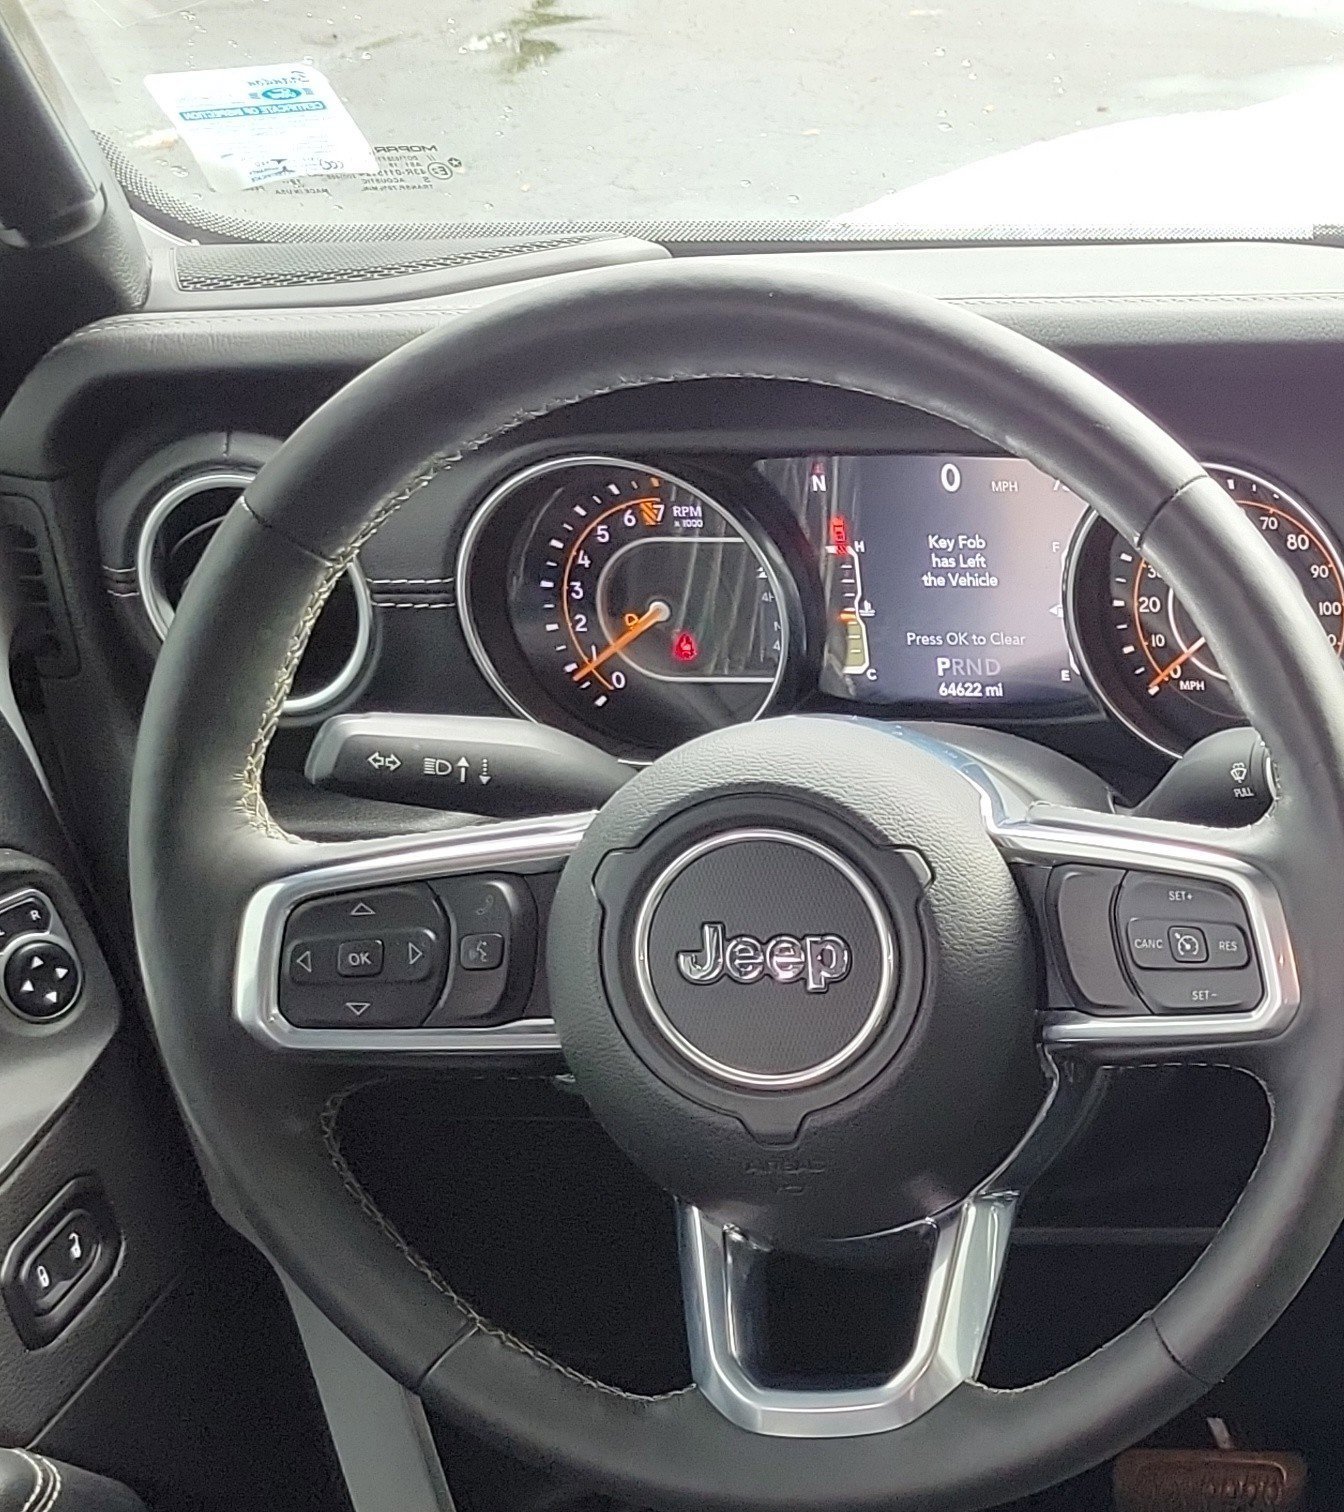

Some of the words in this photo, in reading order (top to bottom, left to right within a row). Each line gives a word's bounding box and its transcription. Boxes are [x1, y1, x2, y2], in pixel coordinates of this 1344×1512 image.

[812, 475, 826, 491] N
[940, 464, 961, 491] 0
[992, 481, 1018, 493] MPH
[624, 510, 636, 526] 6
[673, 506, 702, 518] RPM
[682, 519, 703, 528] 1000
[1260, 517, 1278, 530] 70
[597, 526, 610, 542] 5
[855, 540, 865, 552] H
[928, 535, 955, 550] Key
[958, 535, 986, 549] Fob
[1052, 542, 1060, 552] F
[1287, 535, 1309, 550] 80
[577, 552, 591, 568] 4
[932, 554, 956, 568] has
[960, 553, 986, 568] Left
[1311, 565, 1328, 579] 90
[922, 574, 946, 587] the
[948, 573, 998, 587] Vehicle
[571, 582, 584, 599] 3
[1139, 598, 1160, 612] 20
[1319, 602, 1342, 616] 100
[574, 614, 588, 632] 2
[907, 632, 943, 646] Press
[947, 633, 969, 645] OK
[972, 634, 986, 645] to
[990, 632, 1026, 645] Clear
[1151, 634, 1165, 647] 10
[612, 672, 626, 689] 0
[867, 669, 877, 681] C
[1062, 670, 1070, 681] E
[939, 683, 982, 697] 64622
[986, 682, 1003, 697] mi
[1180, 680, 1205, 691] MPH
[30, 910, 41, 920] R
[1135, 939, 1163, 949] CANC
[1219, 942, 1238, 951] RES
[349, 952, 372, 966] OK
[676, 922, 852, 994] Jeep
